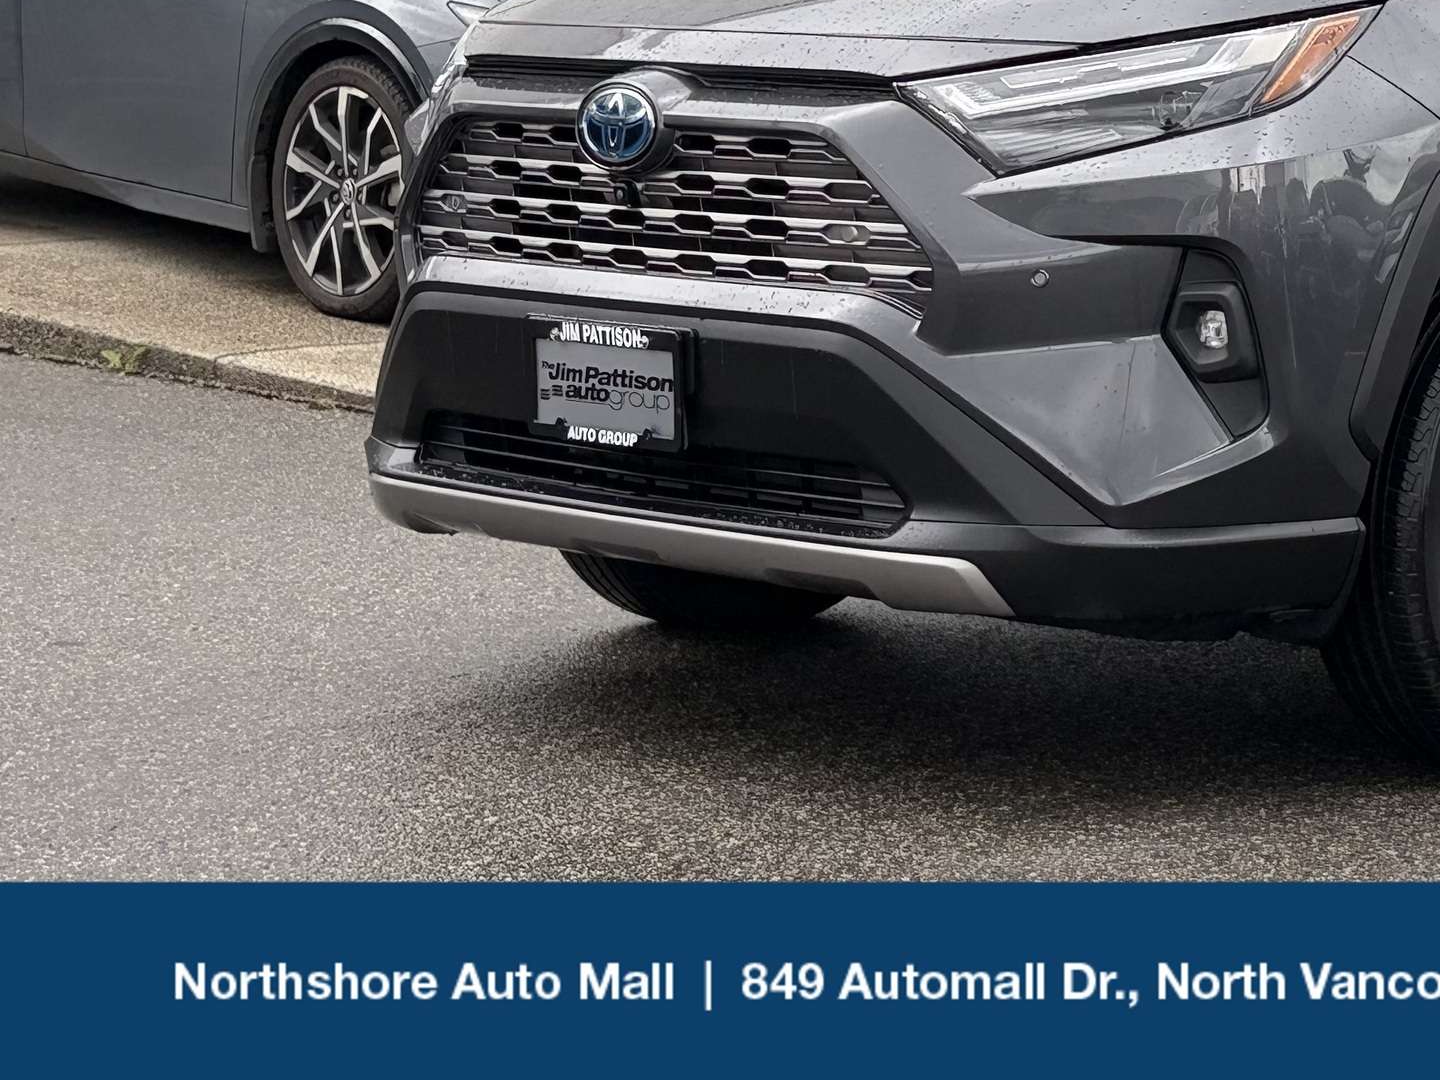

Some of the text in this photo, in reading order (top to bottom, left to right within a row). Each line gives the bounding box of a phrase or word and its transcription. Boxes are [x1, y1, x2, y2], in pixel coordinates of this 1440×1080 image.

[560, 321, 643, 348] JIM PATTISON
[567, 425, 638, 447] AUTO GROUP
